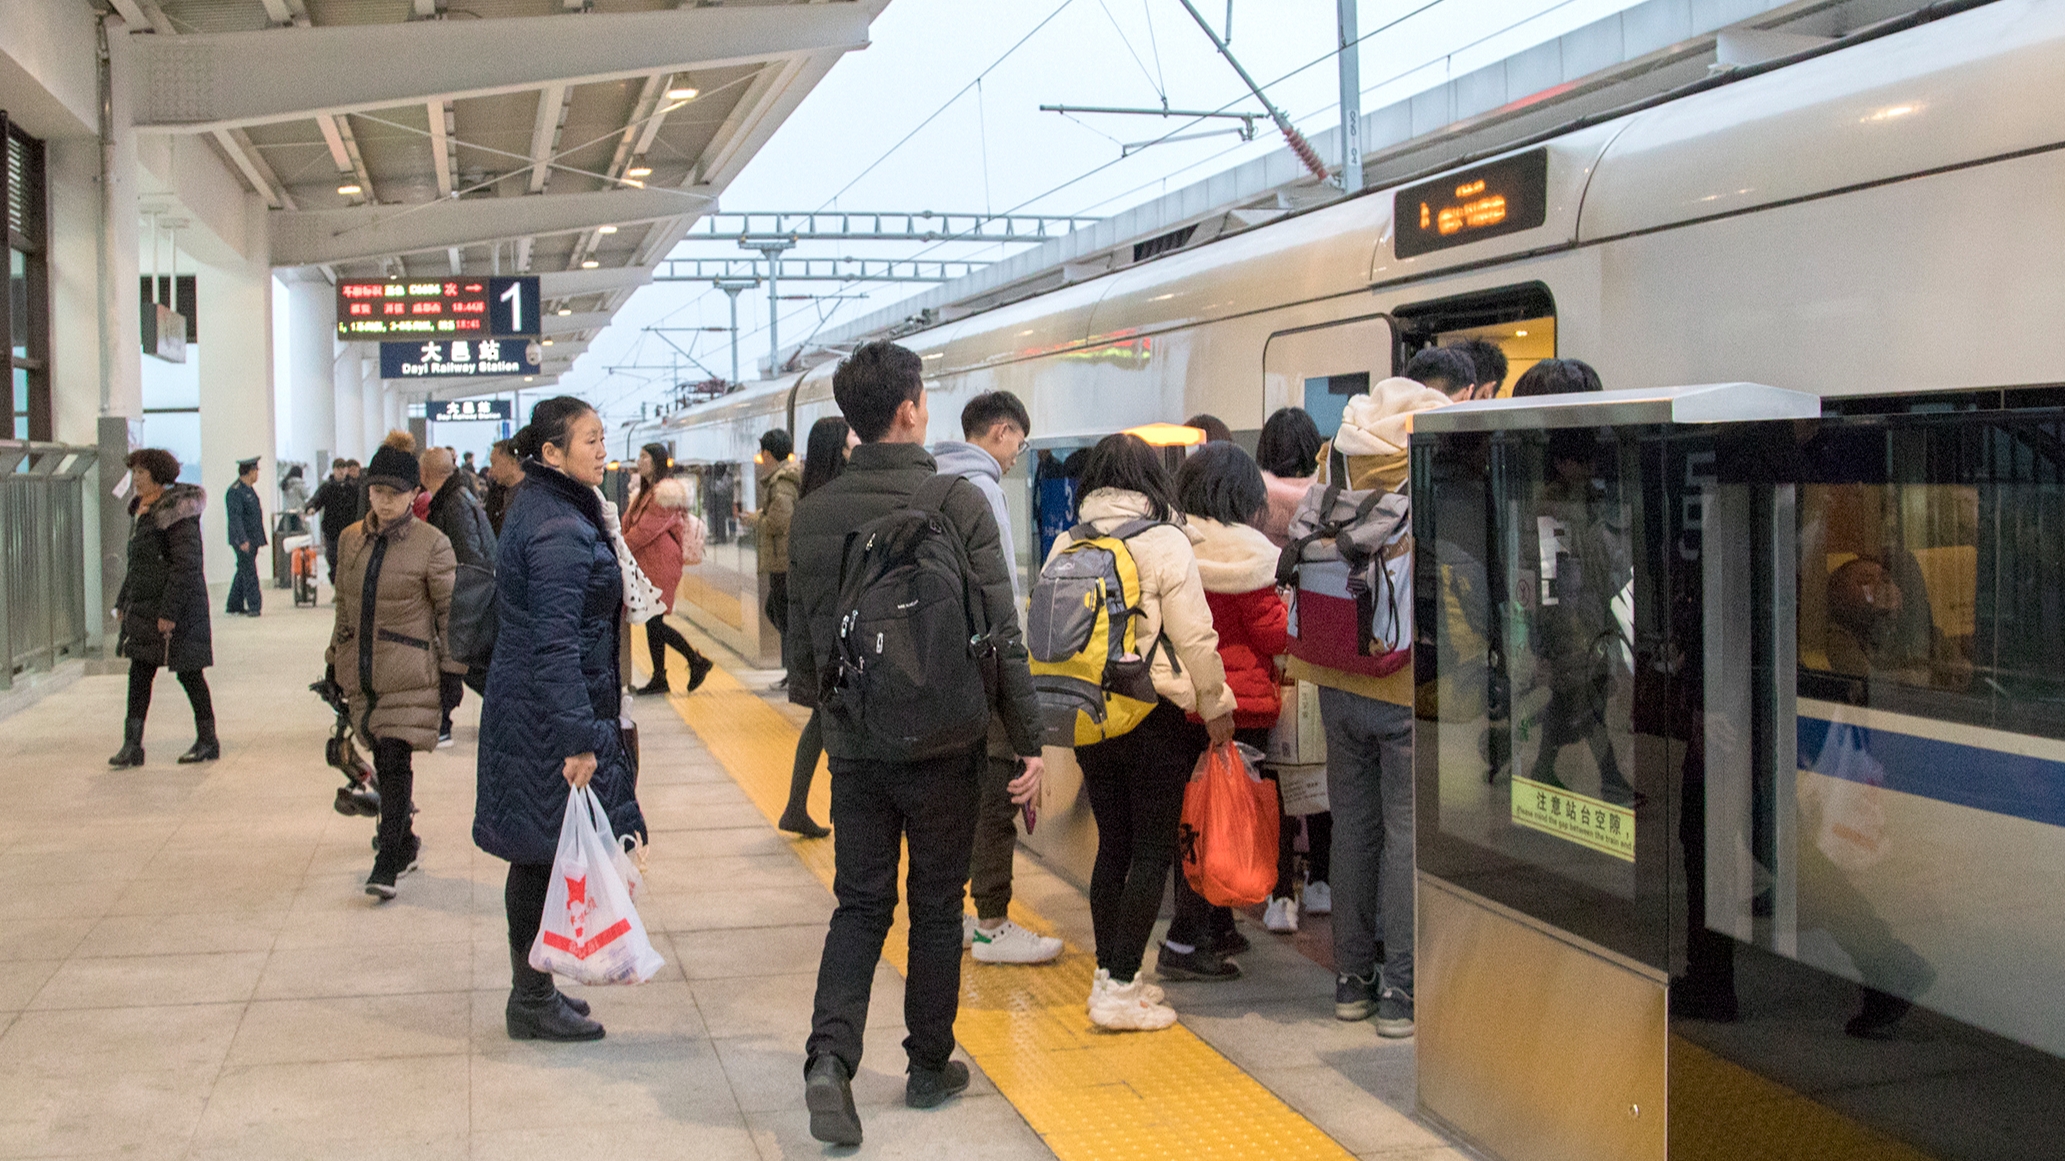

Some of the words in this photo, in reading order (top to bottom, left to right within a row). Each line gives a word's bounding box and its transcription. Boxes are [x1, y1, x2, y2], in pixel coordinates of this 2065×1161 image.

[500, 281, 522, 332] 1
[420, 339, 500, 362] 大邑站
[402, 363, 428, 375] Dayi
[430, 362, 476, 375] Railway
[478, 361, 519, 373] Station
[1548, 815, 1558, 825] the
[1558, 819, 1568, 831] gap
[1569, 822, 1594, 837] between
[1594, 831, 1604, 841] the
[1605, 835, 1619, 846] train
